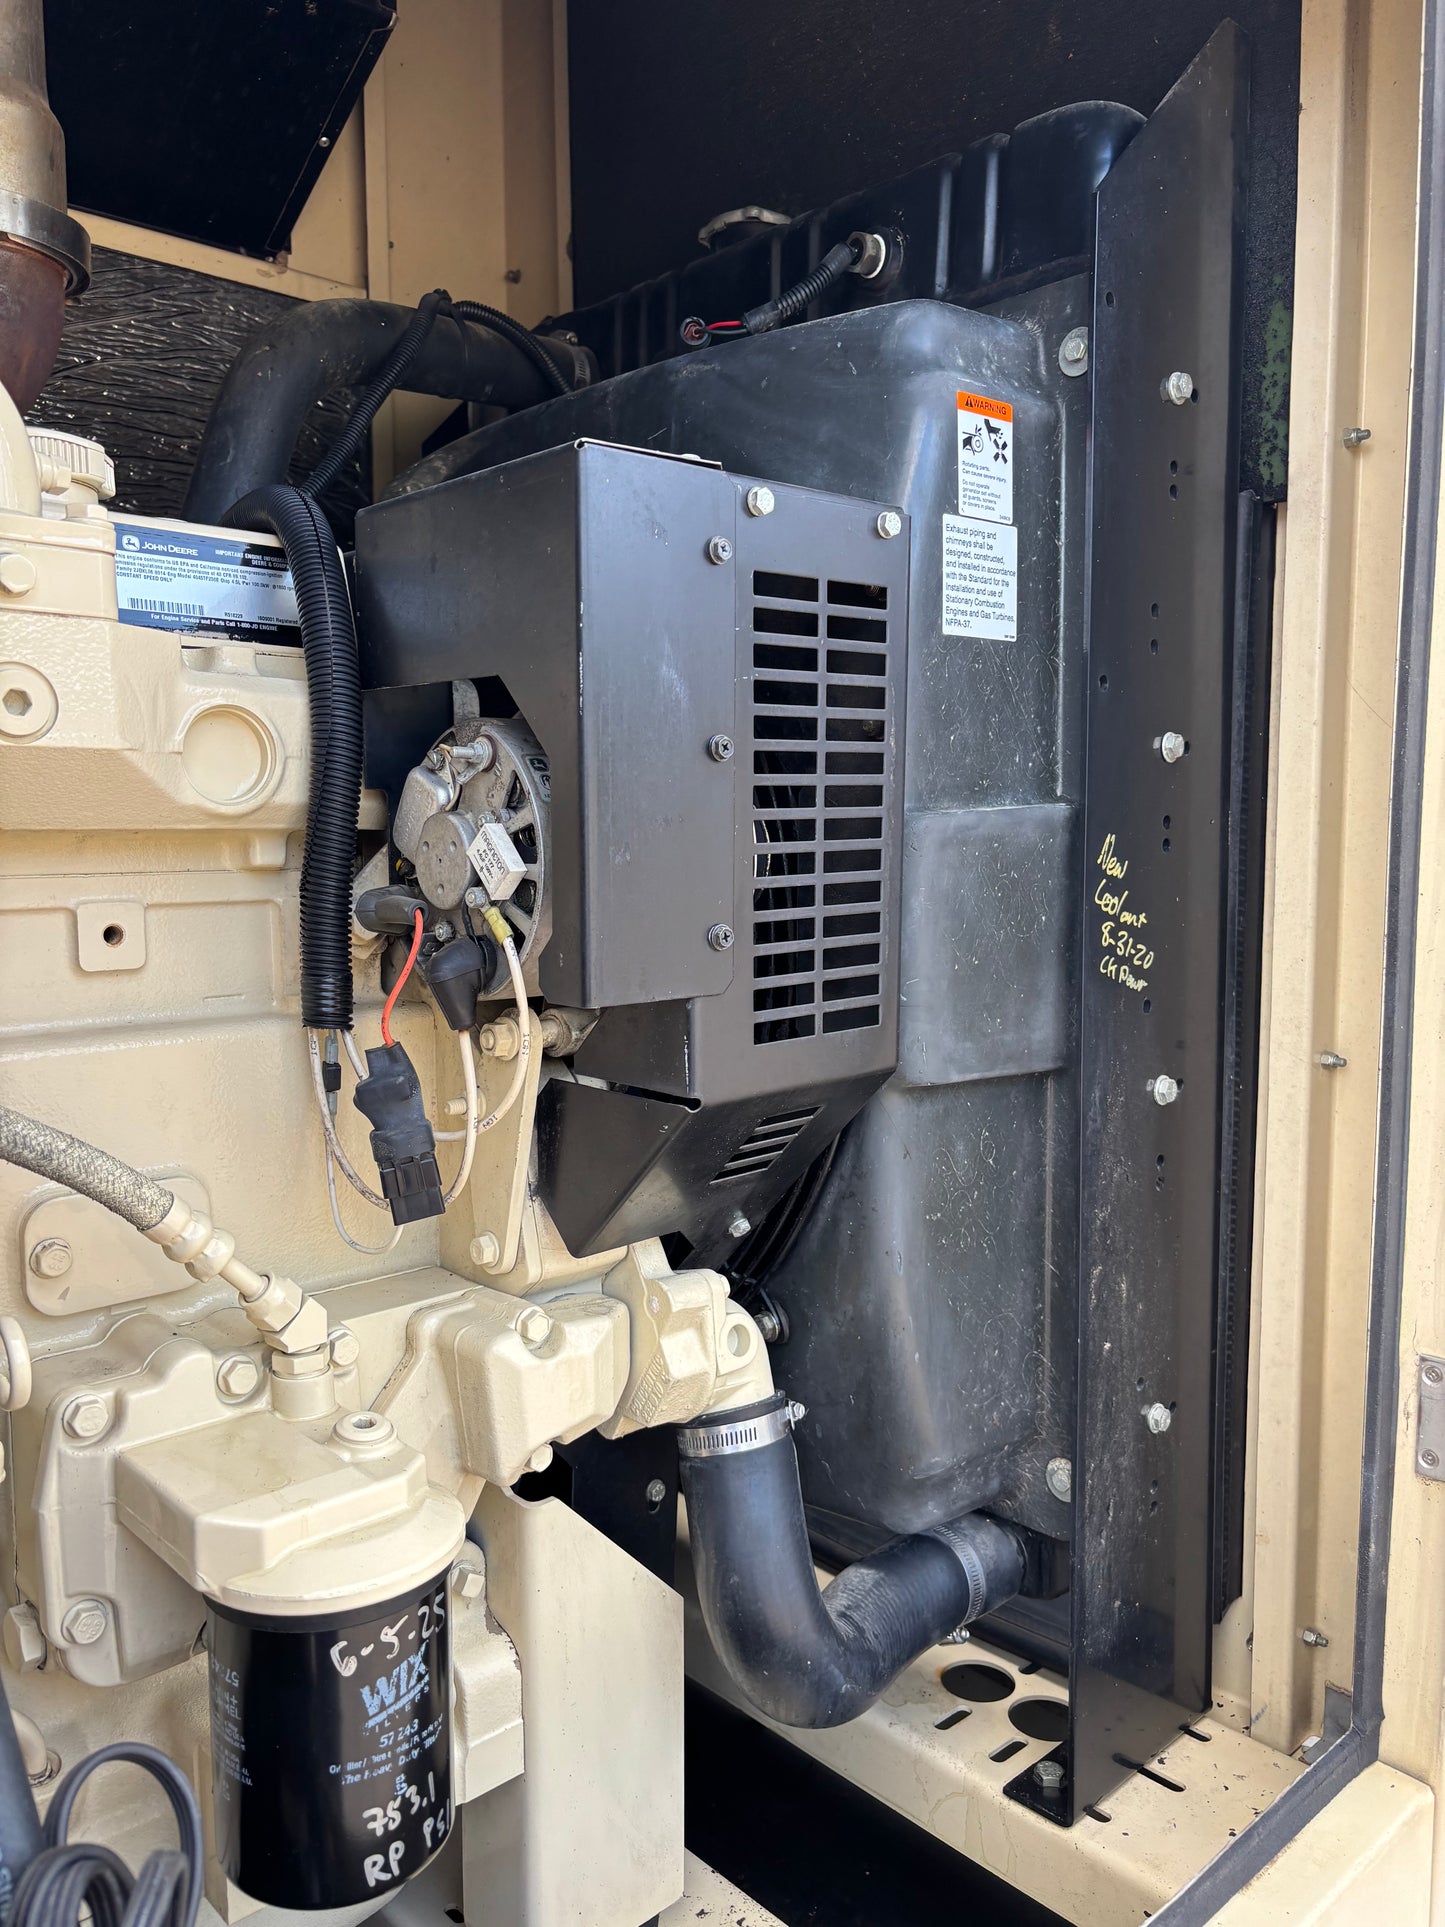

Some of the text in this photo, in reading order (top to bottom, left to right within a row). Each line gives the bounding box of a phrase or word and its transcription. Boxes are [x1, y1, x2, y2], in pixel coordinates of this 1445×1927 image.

[973, 399, 1007, 416] WARNING
[945, 523, 997, 540] Exhaust piping and
[142, 541, 199, 556] JOHN DEERE
[945, 535, 993, 551] chimneys shall be
[945, 548, 1005, 565] designed, constructed,
[945, 560, 956, 568] and
[957, 560, 980, 572] installed
[987, 566, 1016, 578] accordance
[945, 571, 1010, 588] with the Standard for the
[945, 582, 975, 594] Installation
[976, 587, 986, 596] and
[997, 589, 1003, 598] of
[945, 594, 1006, 609] Stationary Combustion
[161, 614, 179, 622] Engine
[180, 616, 199, 624] Service
[211, 619, 225, 627] Parts
[226, 620, 236, 628] Call
[945, 606, 968, 618] Engines
[969, 609, 980, 618] and
[980, 610, 991, 620] Gas
[1097, 833, 1129, 879] New
[360, 1639, 429, 1716] WIX
